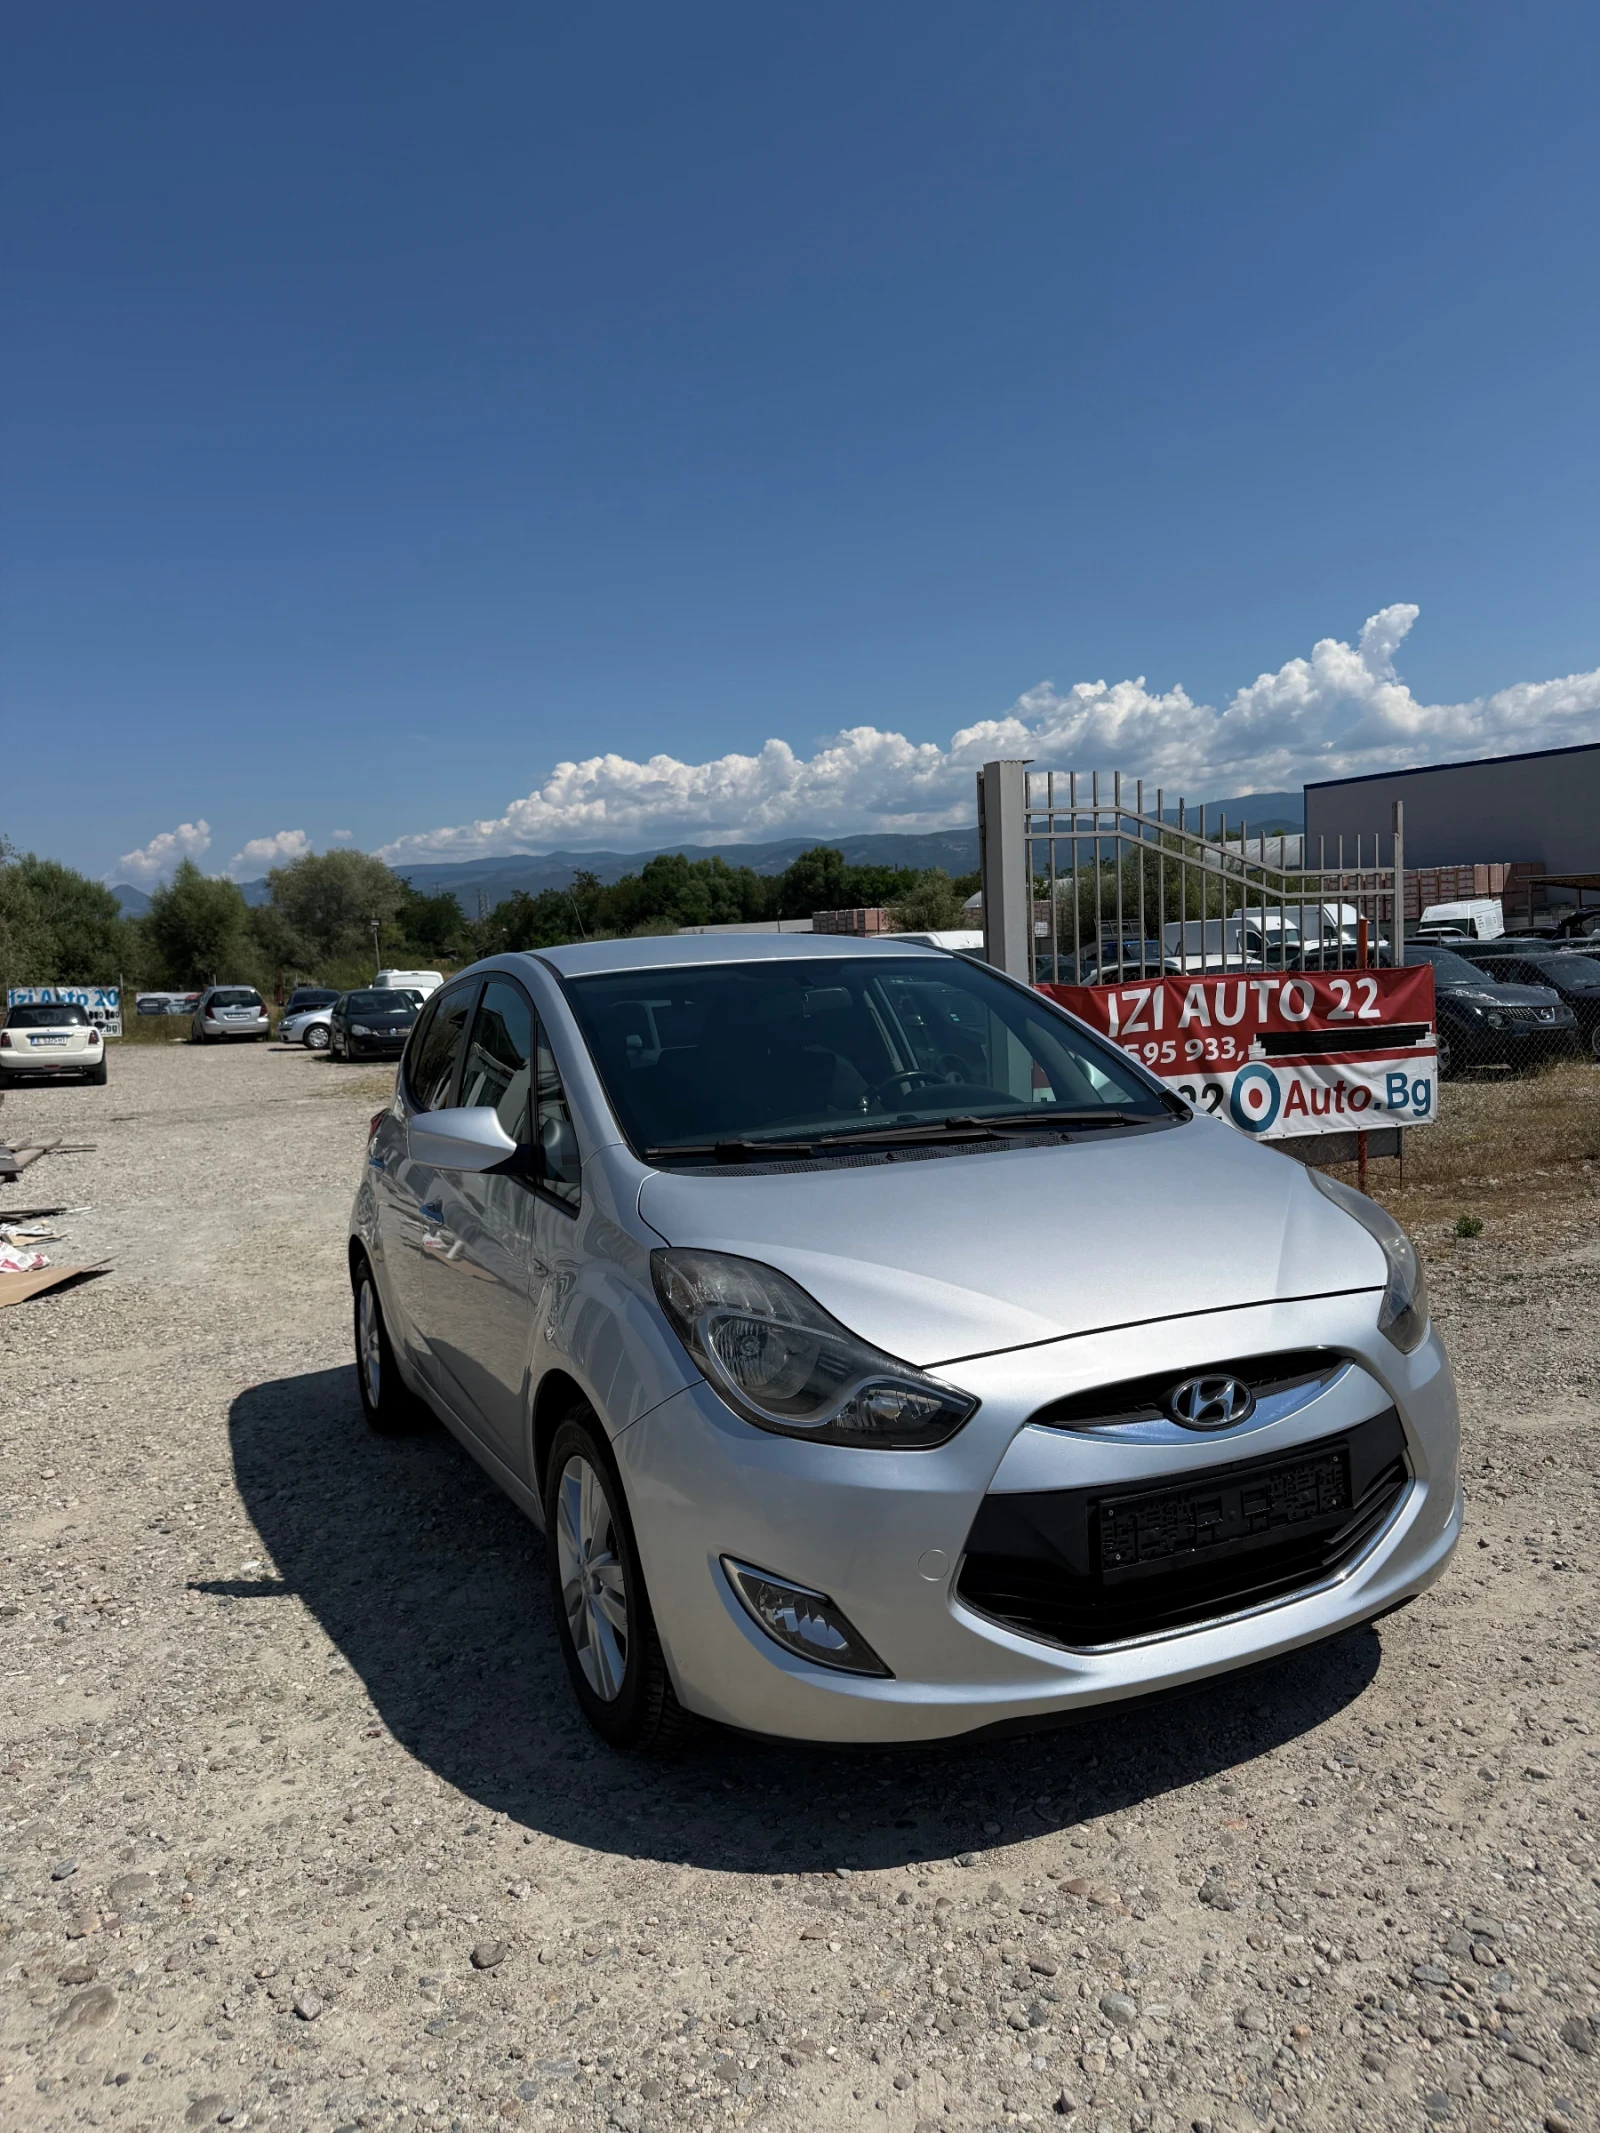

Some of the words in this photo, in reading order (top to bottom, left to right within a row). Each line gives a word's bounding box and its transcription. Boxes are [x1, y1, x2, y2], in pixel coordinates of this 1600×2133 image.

[94, 989, 119, 1007] 20
[1107, 985, 1164, 1038] IZI
[1178, 978, 1316, 1029] AUTO
[1327, 977, 1381, 1020] 22
[1184, 1036, 1245, 1062] 933,
[1283, 1072, 1432, 1119] Auto.Bg
